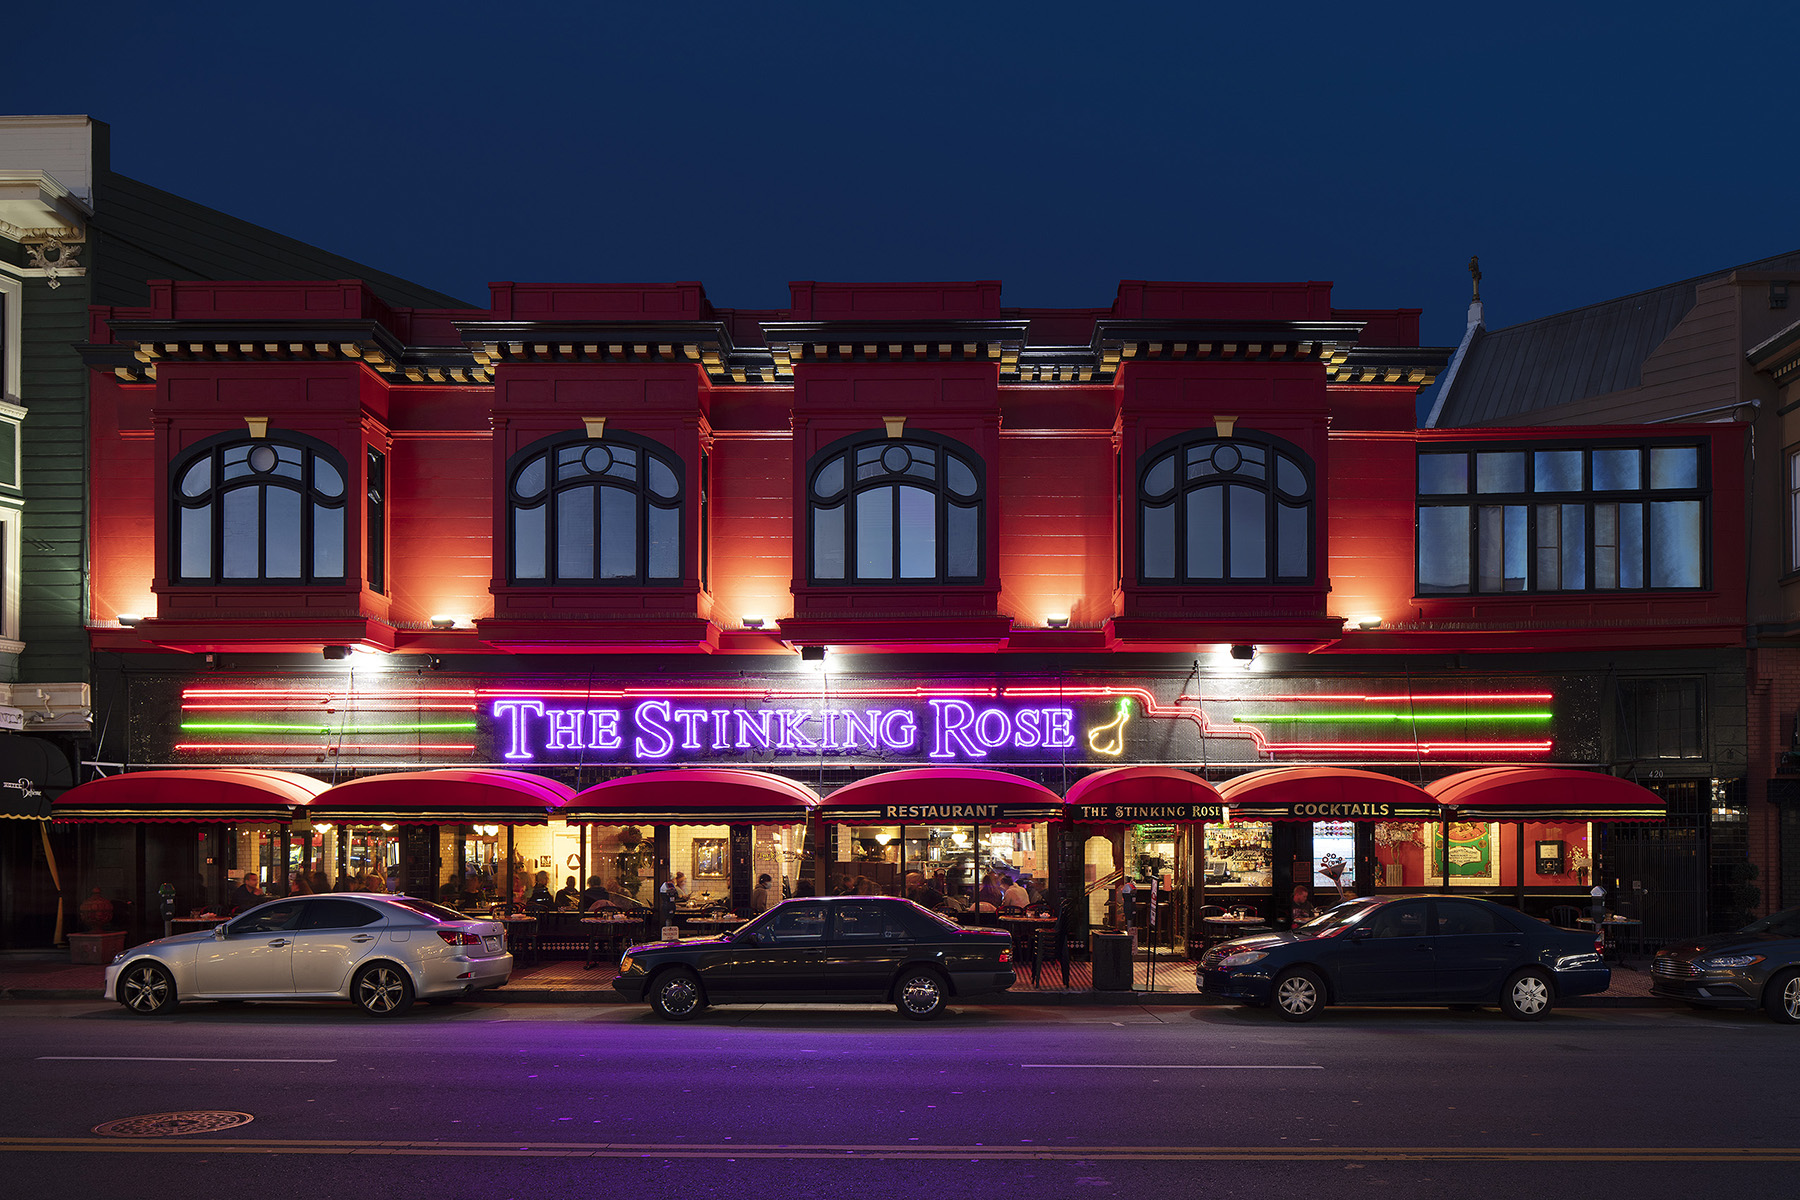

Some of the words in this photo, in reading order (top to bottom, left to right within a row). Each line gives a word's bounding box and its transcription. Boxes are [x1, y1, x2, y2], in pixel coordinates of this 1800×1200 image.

[493, 700, 622, 759] THE
[635, 700, 917, 759] STINKING
[928, 698, 1075, 758] ROSE
[1649, 769, 1664, 779] 420
[887, 805, 999, 818] RESTAURANT
[1080, 806, 1108, 818] THE
[1114, 806, 1186, 818] STINKING
[1192, 805, 1222, 817] ROSE
[1293, 803, 1390, 816] COCKTAILS
